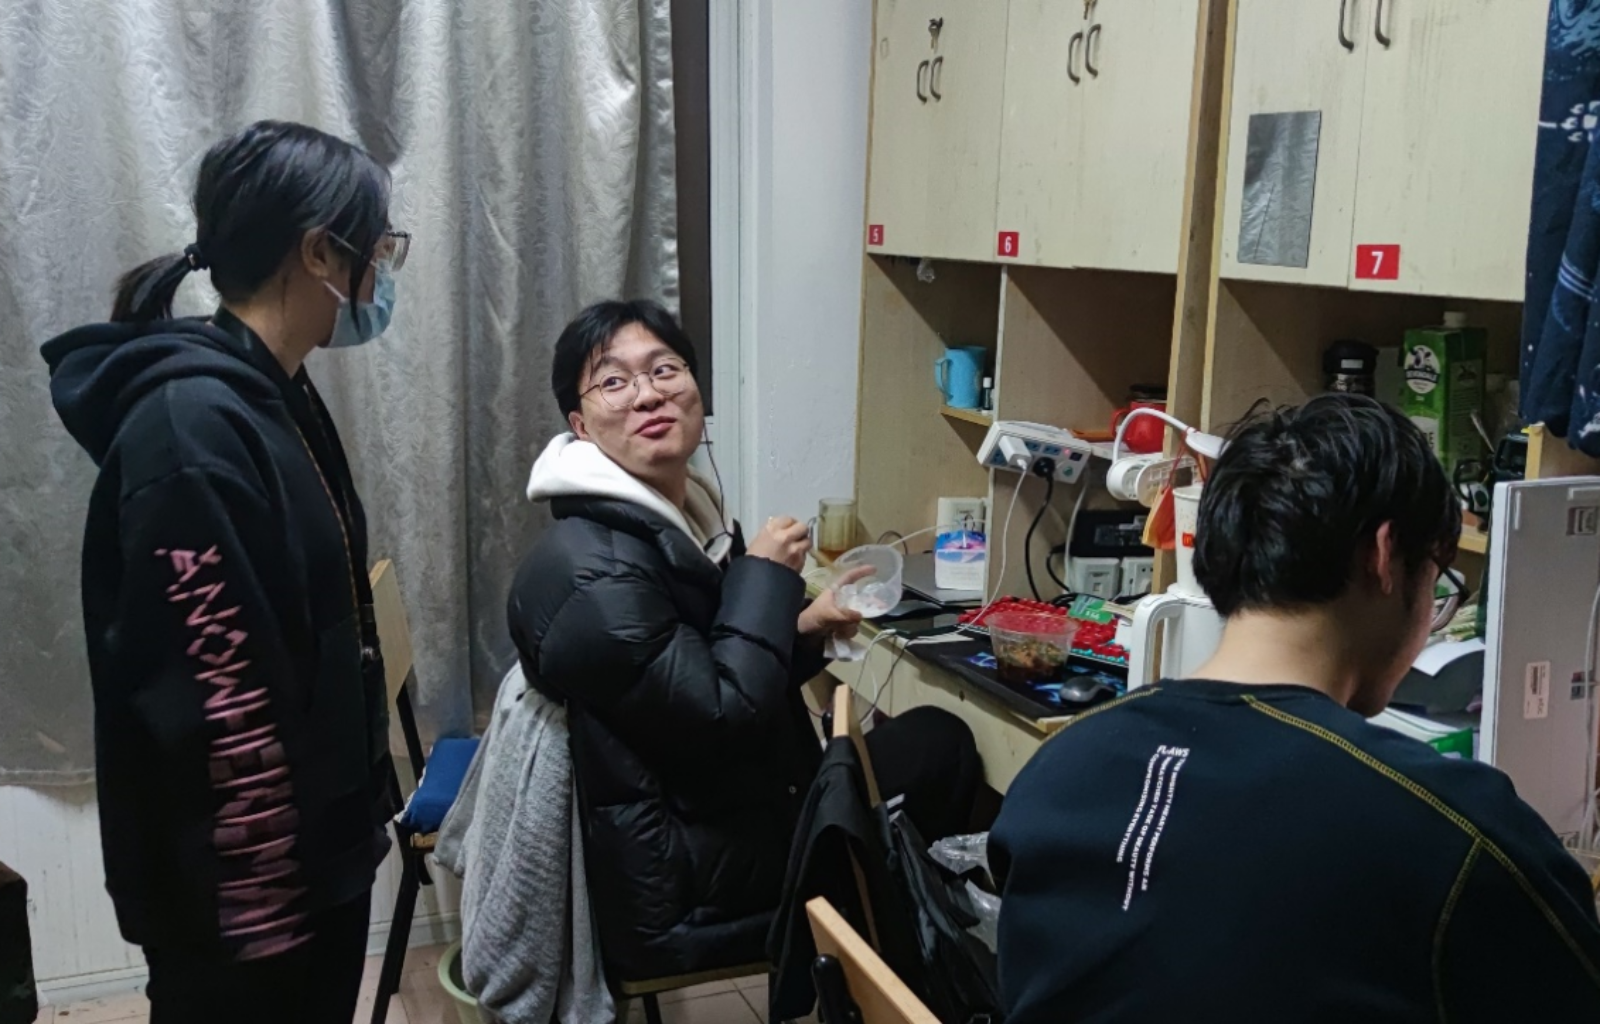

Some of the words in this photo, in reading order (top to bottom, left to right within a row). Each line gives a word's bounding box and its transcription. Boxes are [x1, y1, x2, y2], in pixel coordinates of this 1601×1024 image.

[872, 228, 879, 243] 5
[1004, 235, 1012, 253] 6
[1371, 251, 1384, 275] 7
[1166, 771, 1178, 804] MIGHTY
[1144, 804, 1158, 825] TASK
[1156, 804, 1171, 832] HEART
[1116, 813, 1140, 863] EVERYTHING
[1140, 825, 1149, 836] OF
[1130, 836, 1144, 869] BEAUTY
[1143, 831, 1161, 877] PERFORMS
[1122, 870, 1136, 911] WITHOUT
